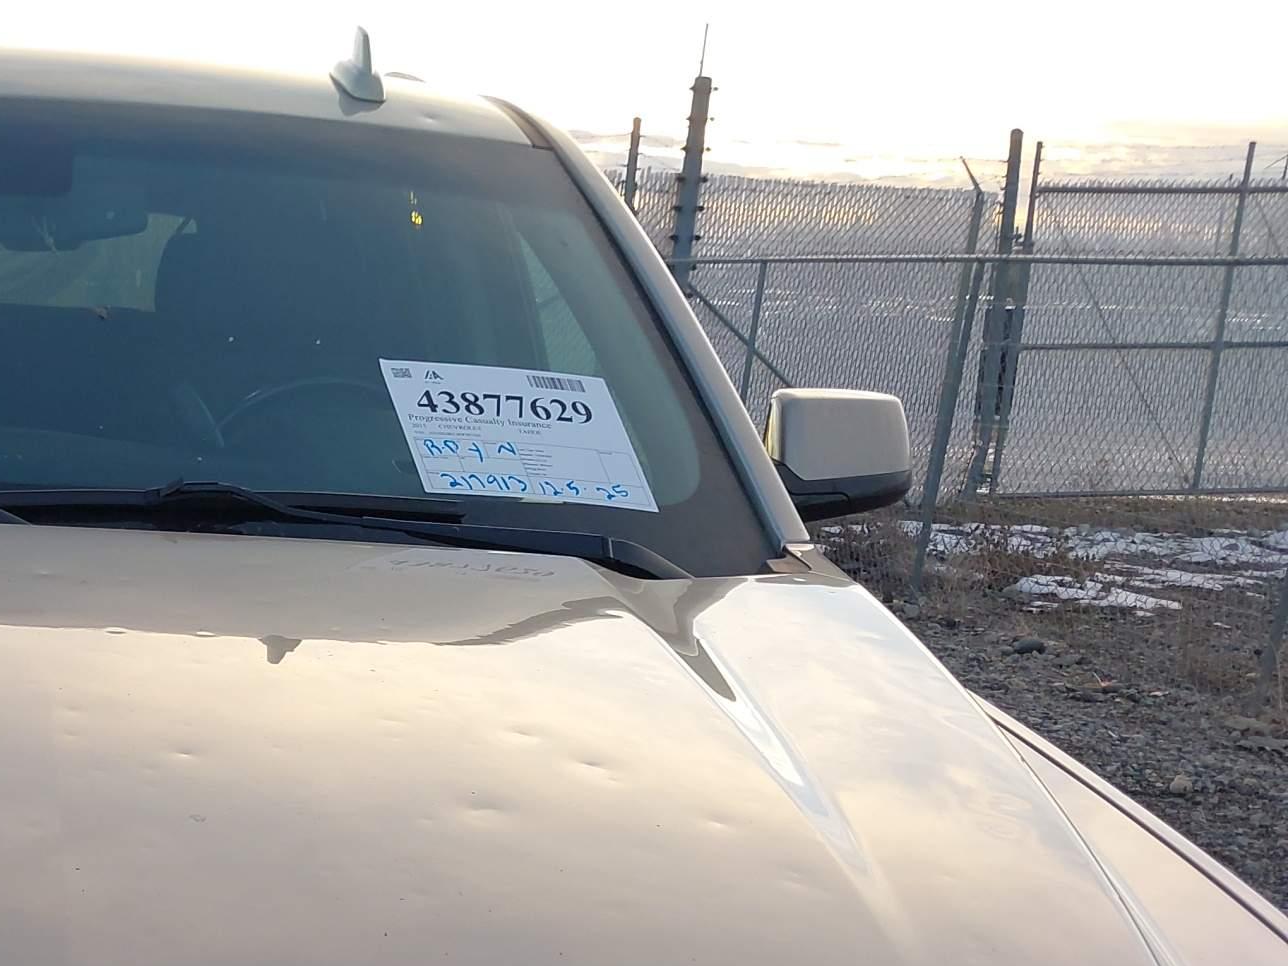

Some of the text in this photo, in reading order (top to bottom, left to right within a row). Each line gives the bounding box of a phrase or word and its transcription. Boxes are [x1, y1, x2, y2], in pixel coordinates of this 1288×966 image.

[417, 390, 592, 424] 43877629
[408, 413, 552, 430] Progressive Casualty Insurance
